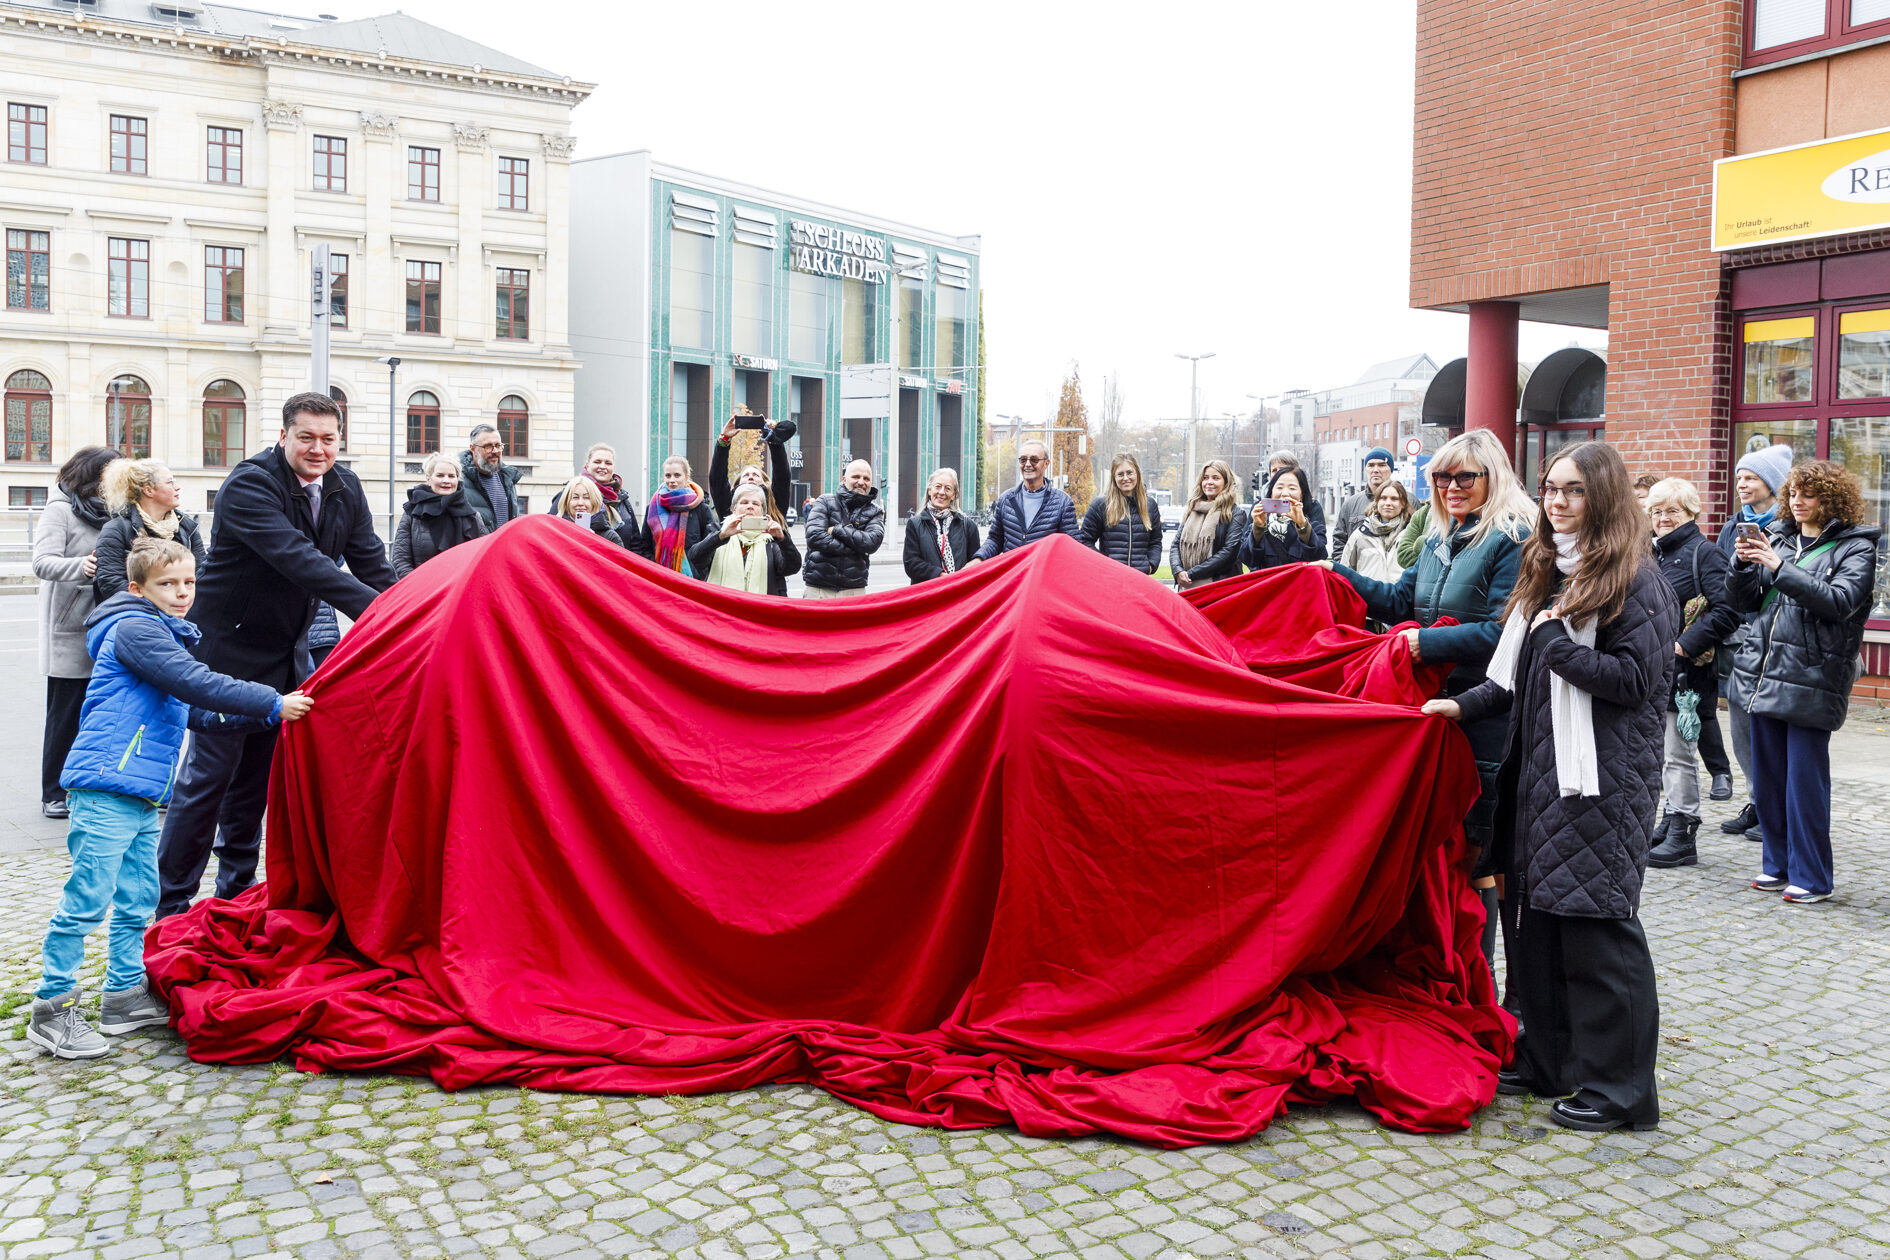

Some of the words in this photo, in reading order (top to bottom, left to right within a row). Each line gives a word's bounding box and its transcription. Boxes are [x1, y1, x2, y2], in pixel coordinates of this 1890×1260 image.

[1848, 167, 1890, 195] RE
[1724, 223, 1734, 231] Ihr
[1736, 218, 1762, 229] Urlaub
[1734, 230, 1757, 239] unsere
[803, 221, 884, 261] SCHLOSS
[799, 245, 887, 285] ARKADEN
[750, 356, 778, 371] SATURN
